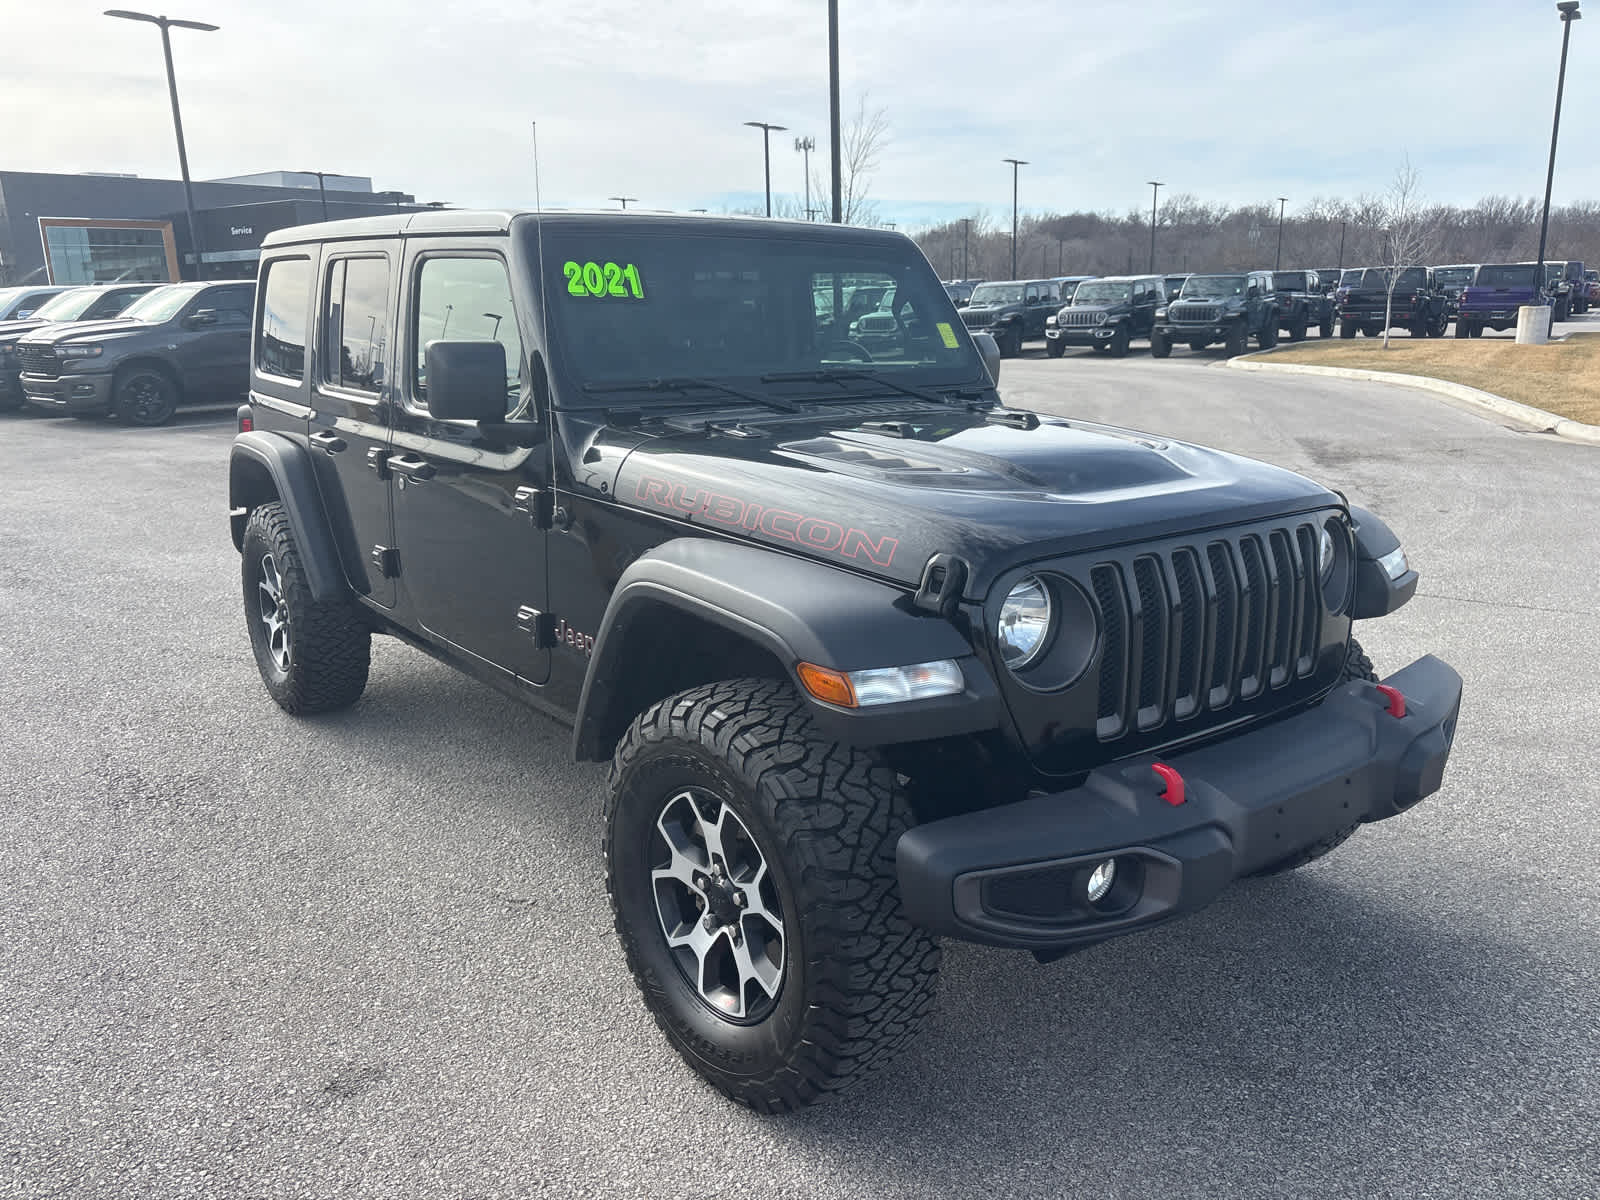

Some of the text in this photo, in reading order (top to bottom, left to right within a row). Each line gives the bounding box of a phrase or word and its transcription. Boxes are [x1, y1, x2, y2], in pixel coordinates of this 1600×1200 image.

[231, 226, 253, 235] Service
[563, 261, 645, 299] 2021
[635, 475, 899, 567] RUBICON
[554, 619, 595, 658] Jeep
